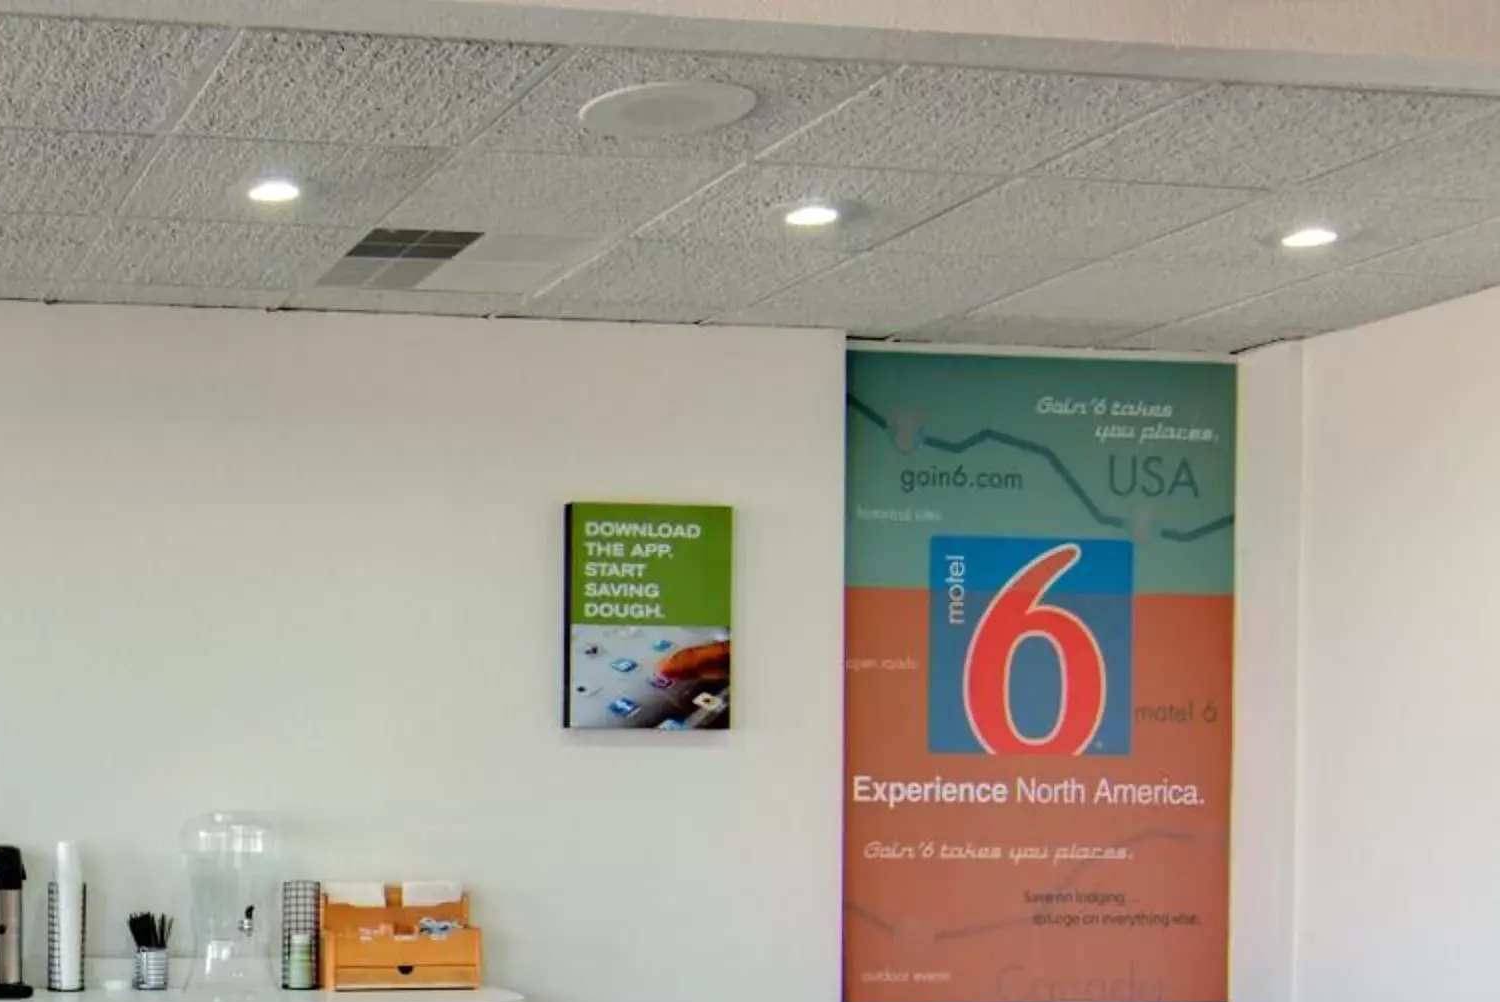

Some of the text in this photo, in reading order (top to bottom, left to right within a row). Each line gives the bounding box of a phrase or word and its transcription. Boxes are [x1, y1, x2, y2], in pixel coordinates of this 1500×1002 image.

[1111, 399, 1173, 418] takes
[1094, 423, 1136, 445] you
[900, 463, 1023, 494] goin6.com
[1108, 453, 1200, 499] USA
[584, 520, 701, 539] DOWNLOAD
[584, 542, 674, 559] THE APP.
[584, 562, 647, 578] START
[584, 582, 660, 598] SAVING
[583, 602, 665, 619] DOUGH.
[945, 542, 1107, 756] motel 6
[1136, 701, 1218, 723] motel 6
[853, 775, 1205, 808] Experience North America.
[939, 842, 1003, 860] takes
[1008, 845, 1049, 865] you
[1082, 914, 1100, 926] on
[1101, 912, 1170, 928] everything
